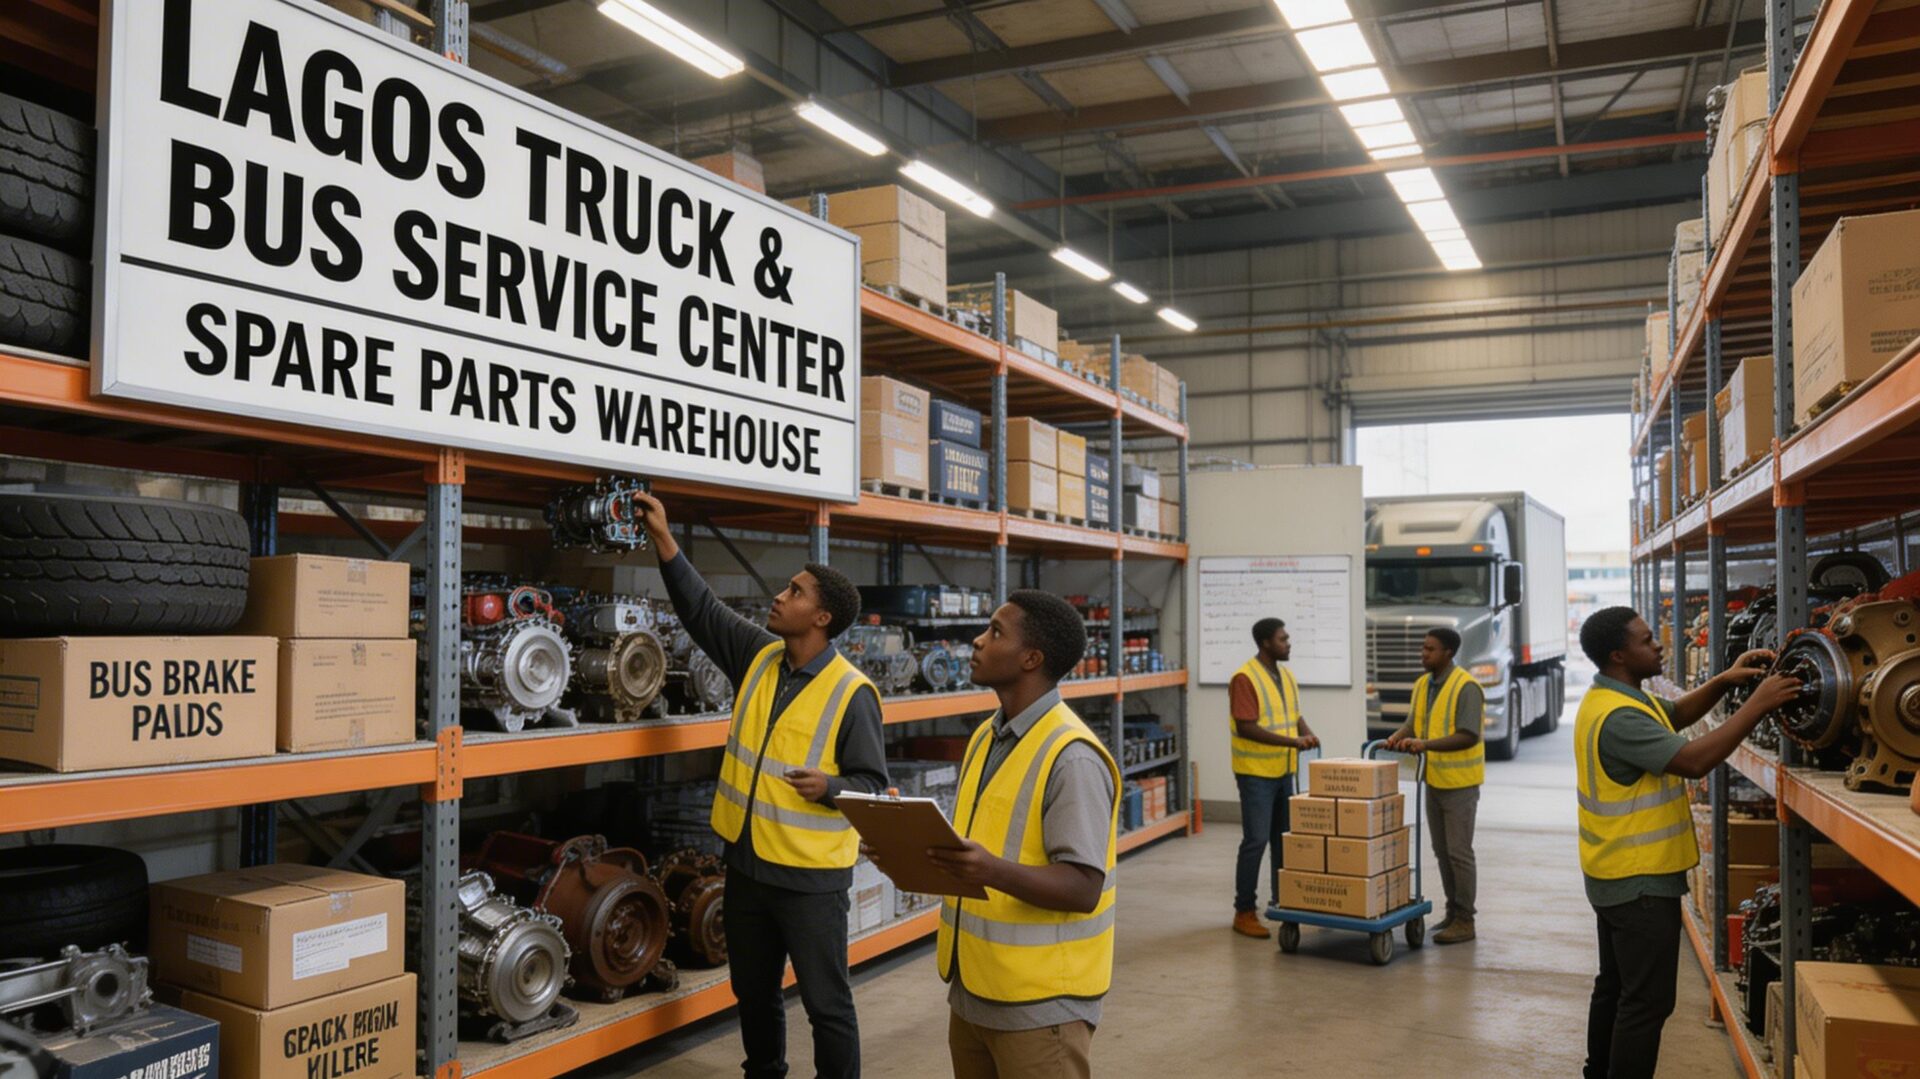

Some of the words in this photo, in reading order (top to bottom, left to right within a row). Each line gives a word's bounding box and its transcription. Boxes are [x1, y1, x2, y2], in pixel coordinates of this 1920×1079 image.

[160, 0, 486, 199] LAGOS
[516, 127, 735, 286] TRUCK
[753, 226, 794, 305] &
[168, 139, 363, 283] BUS
[392, 209, 658, 357] SERVICE
[678, 294, 846, 403] CENTER
[183, 302, 395, 406] SPARE
[420, 348, 577, 434] PARTS
[594, 384, 821, 476] WAREHOUSE
[90, 659, 152, 699] BUS
[163, 659, 257, 696] BRAKE
[132, 701, 224, 742] PALDS
